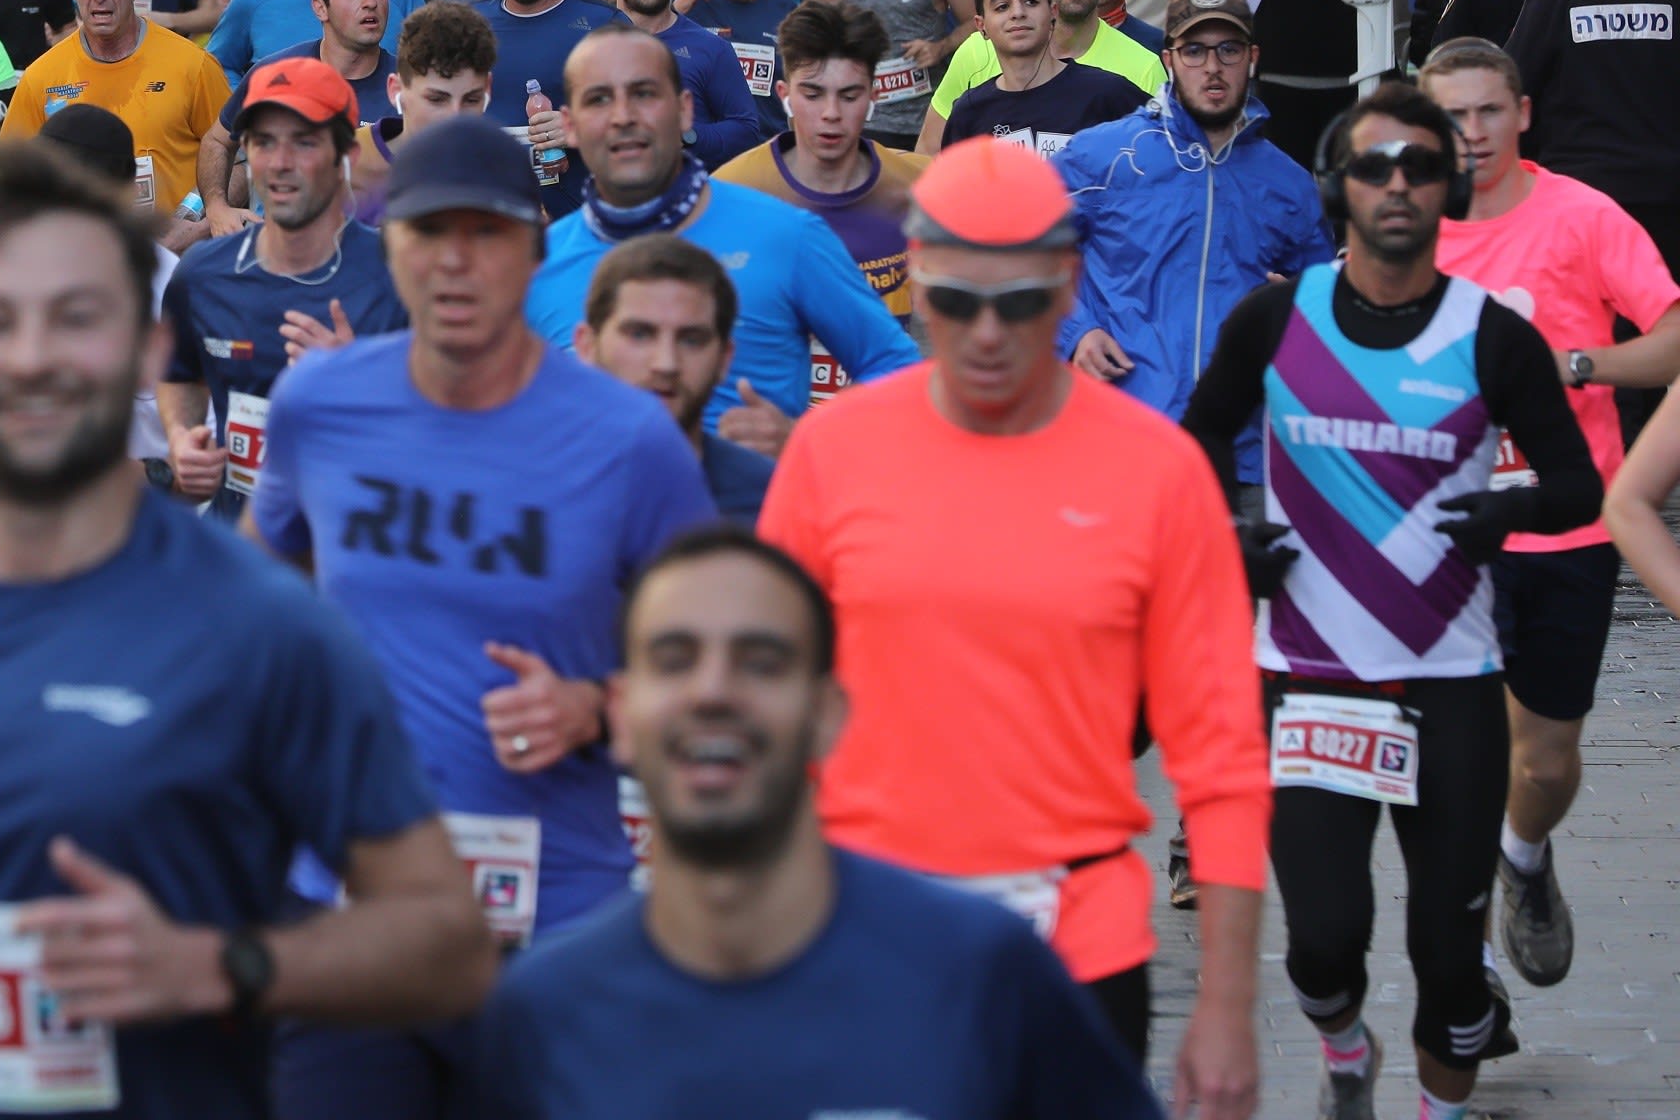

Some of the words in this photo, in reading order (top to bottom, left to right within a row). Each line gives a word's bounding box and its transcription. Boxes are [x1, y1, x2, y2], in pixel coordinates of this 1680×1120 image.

[1576, 13, 1669, 34] משטרה
[884, 73, 909, 90] 6276
[816, 366, 827, 381] C
[233, 436, 245, 454] B
[1283, 415, 1458, 463] TRIHARD
[1285, 731, 1300, 748] A
[1310, 726, 1369, 765] 8027
